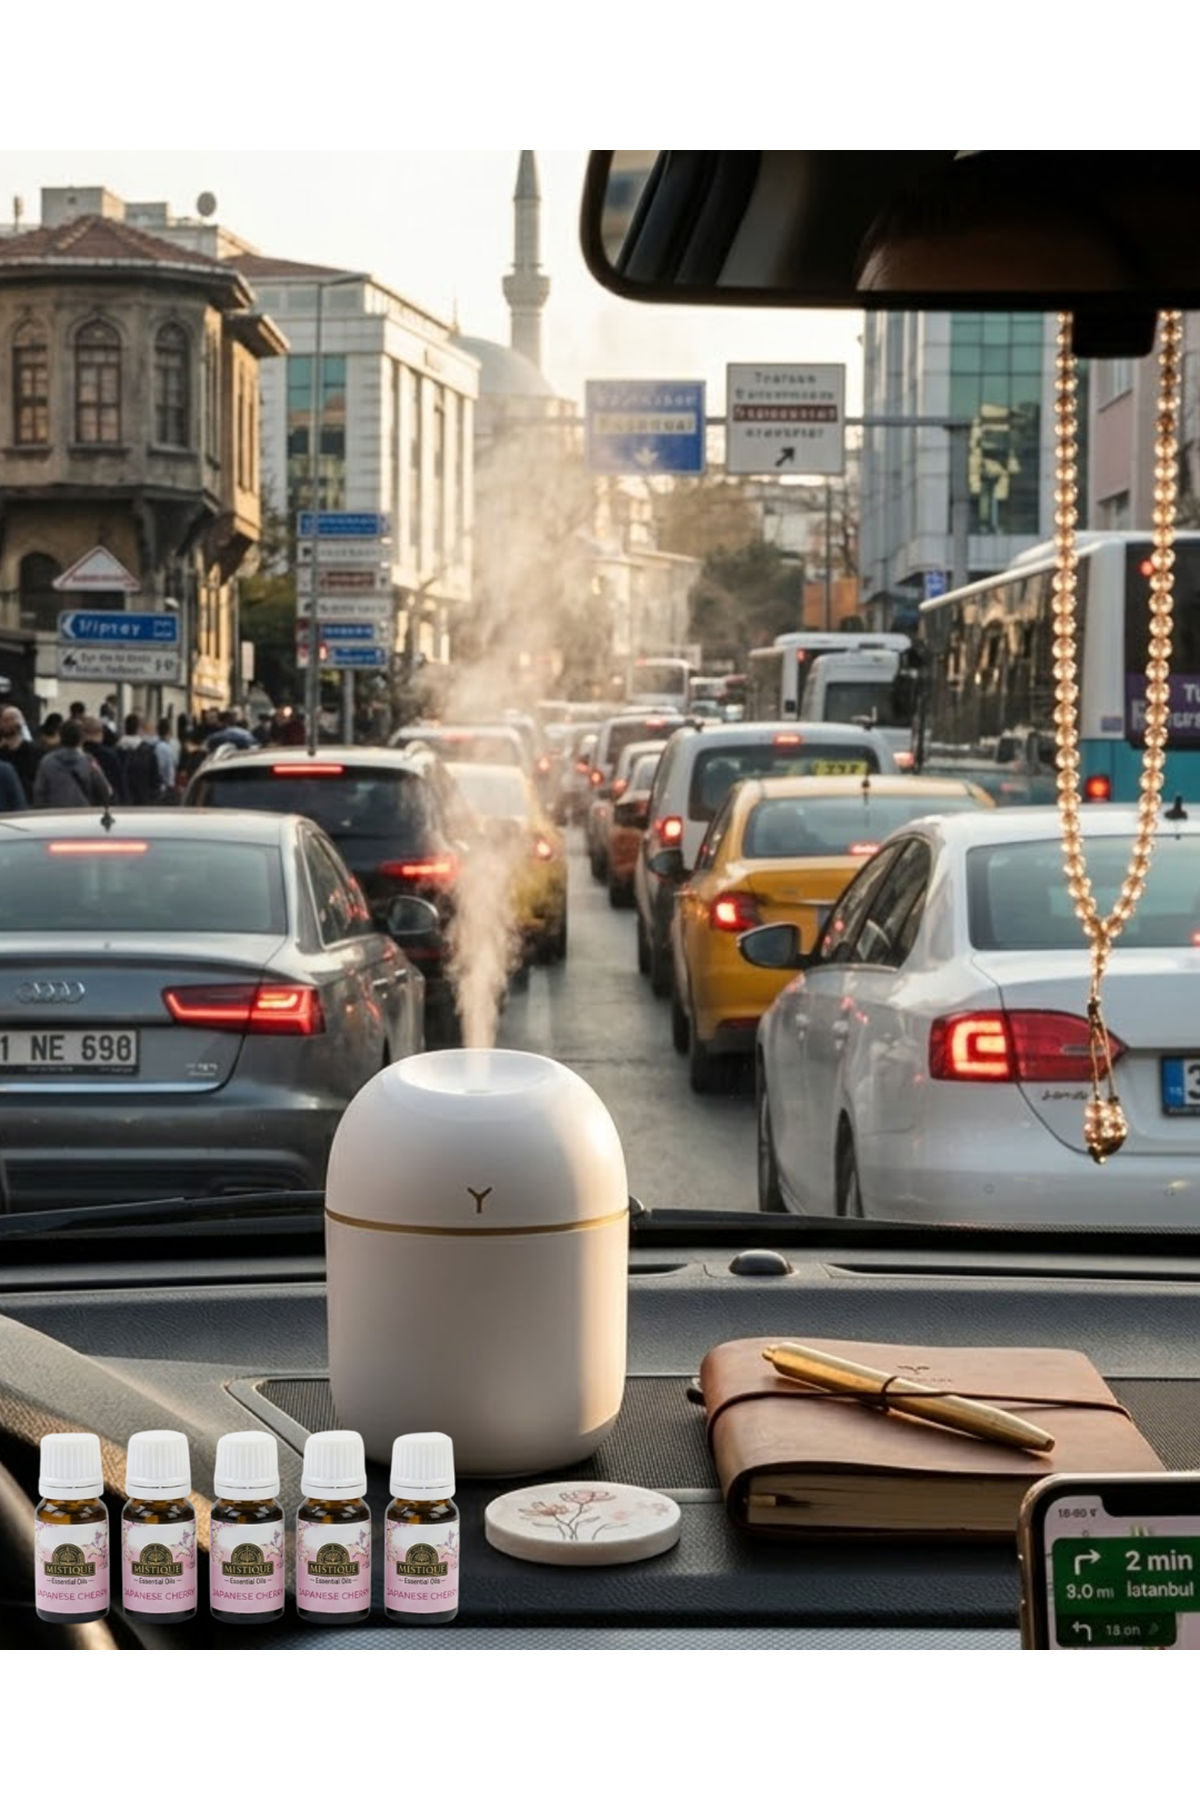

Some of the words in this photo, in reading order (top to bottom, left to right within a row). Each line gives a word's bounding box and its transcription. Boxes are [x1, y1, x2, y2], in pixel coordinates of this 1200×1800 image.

[31, 1034, 65, 1061] NE
[1125, 1550, 1141, 1571] 2
[1147, 1549, 1193, 1571] min
[46, 1565, 93, 1575] MISTIQUE
[133, 1565, 180, 1575] MISTIQUE
[224, 1565, 272, 1575] MISTIQUE
[309, 1565, 356, 1575] MISTIQUE
[398, 1565, 446, 1575] MISTIQUE
[51, 1577, 76, 1585] Essential
[139, 1577, 163, 1585] Essential
[229, 1577, 255, 1585] Essential
[315, 1577, 340, 1585] Essential
[404, 1577, 429, 1585] Essential
